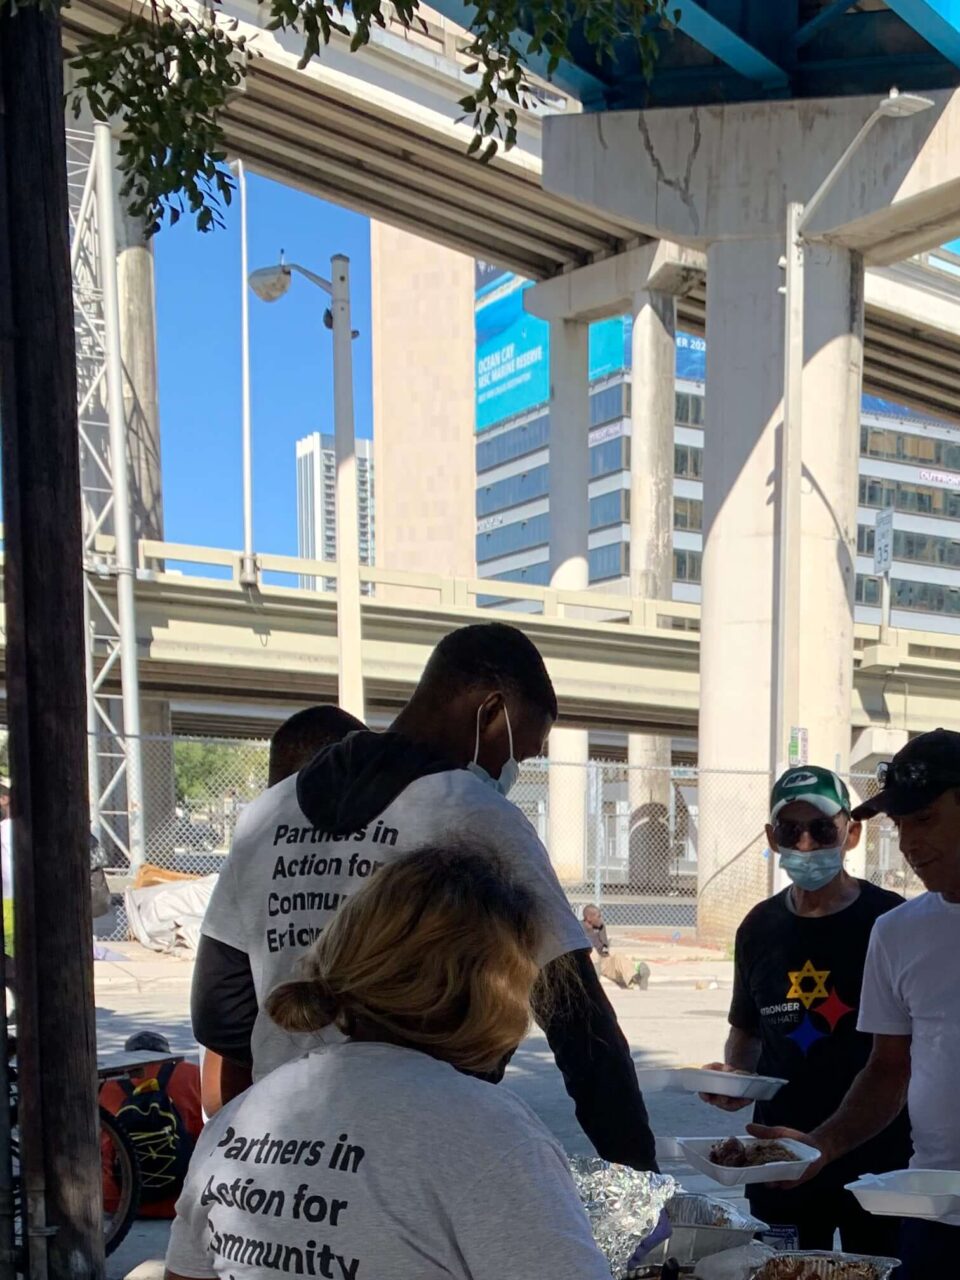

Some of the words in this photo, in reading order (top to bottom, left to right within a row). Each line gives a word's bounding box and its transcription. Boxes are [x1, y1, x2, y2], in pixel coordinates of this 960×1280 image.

[478, 350, 501, 374] OCEAN
[501, 343, 515, 362] CAY
[877, 544, 889, 564] 35
[372, 820, 399, 846] in
[272, 853, 343, 880] Action
[328, 1133, 365, 1173] in
[201, 1175, 285, 1218] Action
[293, 1183, 349, 1226] for
